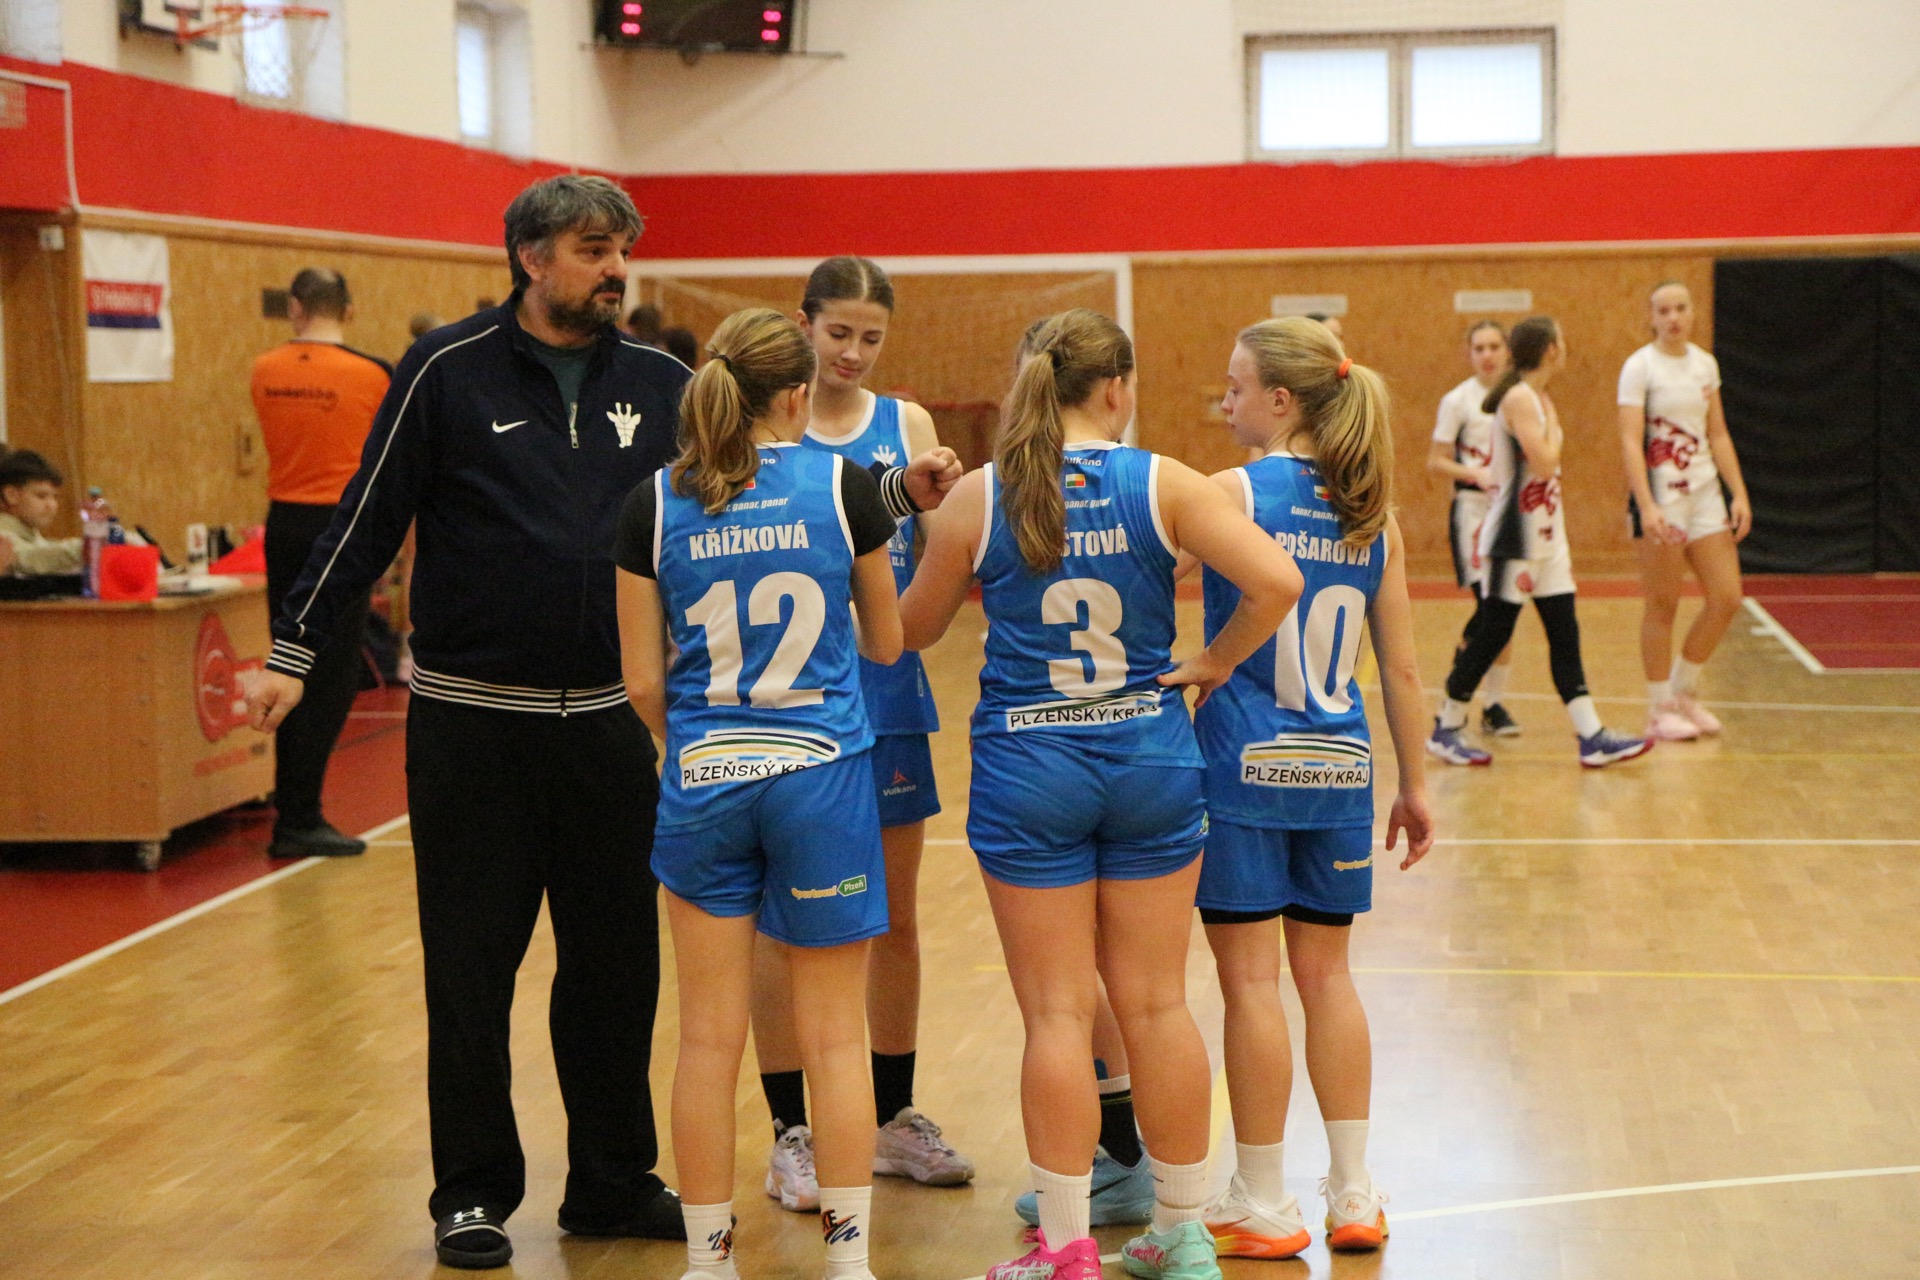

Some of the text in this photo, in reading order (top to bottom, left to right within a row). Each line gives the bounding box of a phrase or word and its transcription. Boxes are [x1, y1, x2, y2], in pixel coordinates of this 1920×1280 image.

[761, 498, 789, 509] ganar
[689, 520, 809, 560] KŘÍŽKOVÁ
[685, 572, 826, 709] 12
[1041, 578, 1130, 698] 3
[1275, 584, 1366, 714] 10
[684, 761, 775, 784] PLZEŇSKÝ
[1245, 766, 1369, 784] PLZEŇSKÝ KRAJ
[844, 880, 865, 892] Plzeň
